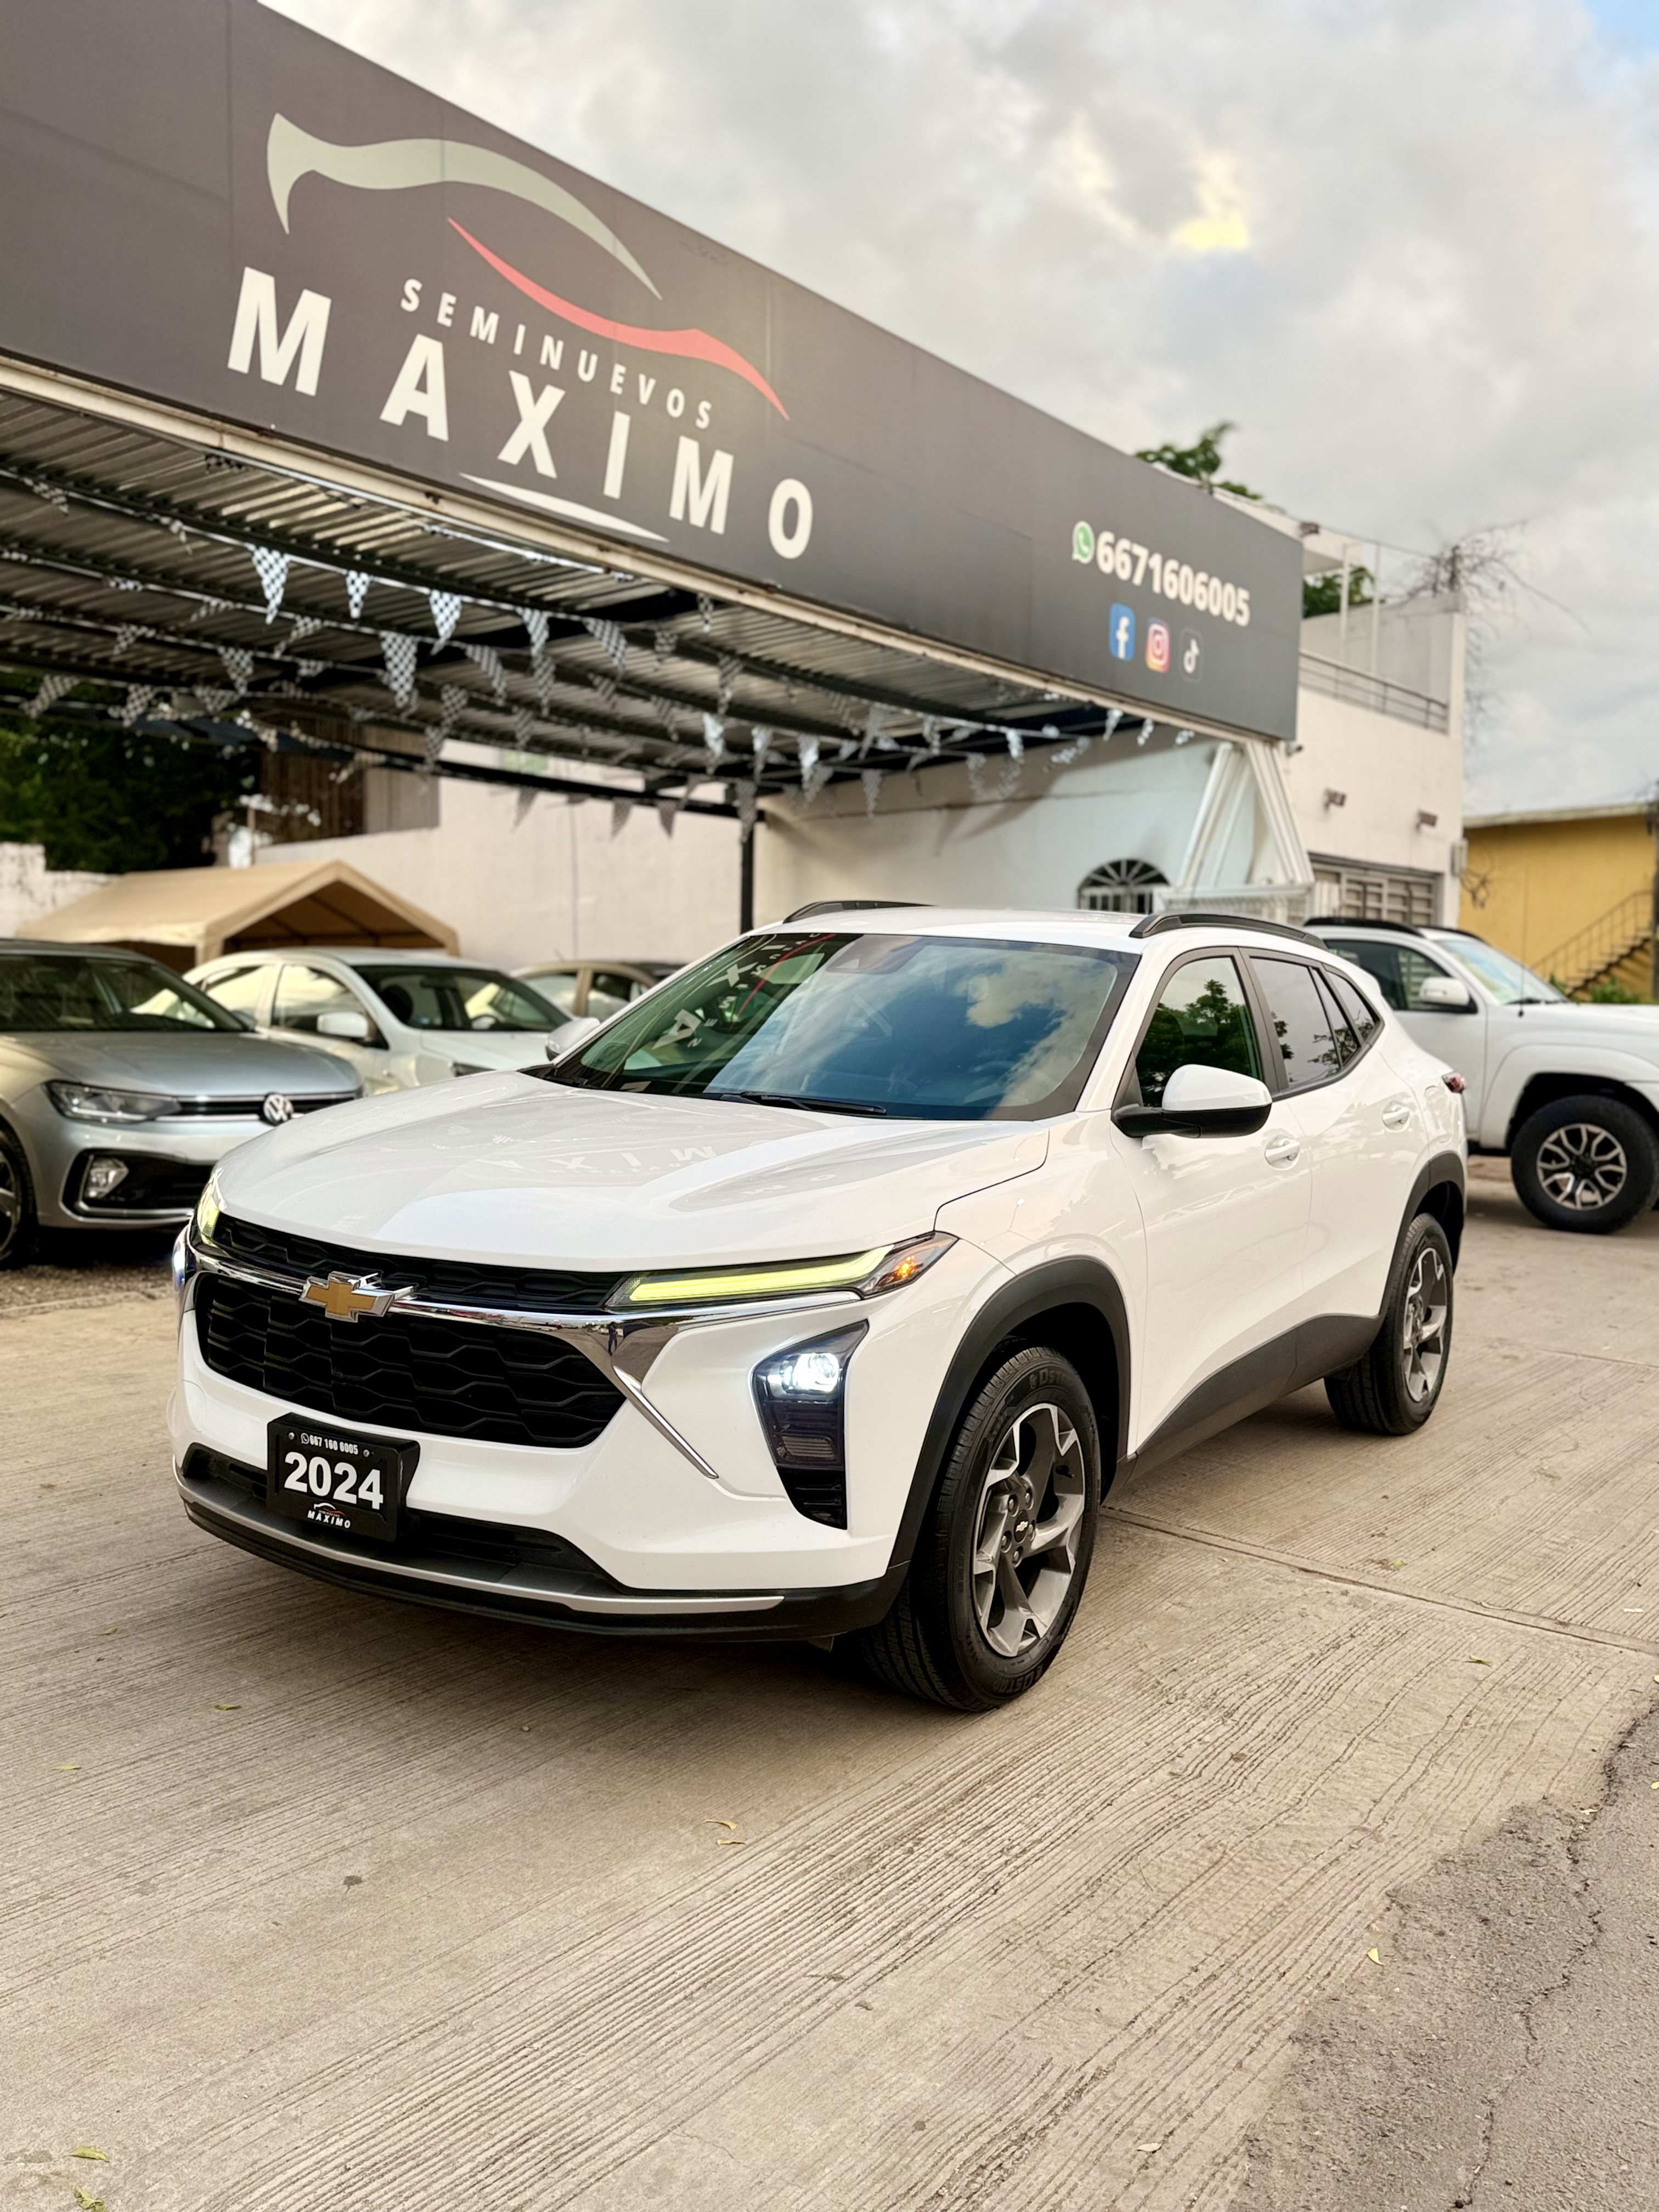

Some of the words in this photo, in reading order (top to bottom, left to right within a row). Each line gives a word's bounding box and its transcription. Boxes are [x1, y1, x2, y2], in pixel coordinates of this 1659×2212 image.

[400, 278, 712, 430] SEMINUEVOS
[227, 266, 814, 559] MAXIMO
[1096, 531, 1250, 627] 6671606005
[284, 1451, 383, 1510] 2024
[309, 1434, 323, 1447] 667
[324, 1438, 338, 1451] 160
[340, 1441, 359, 1455] 6005
[307, 1510, 351, 1528] MAXIMO
